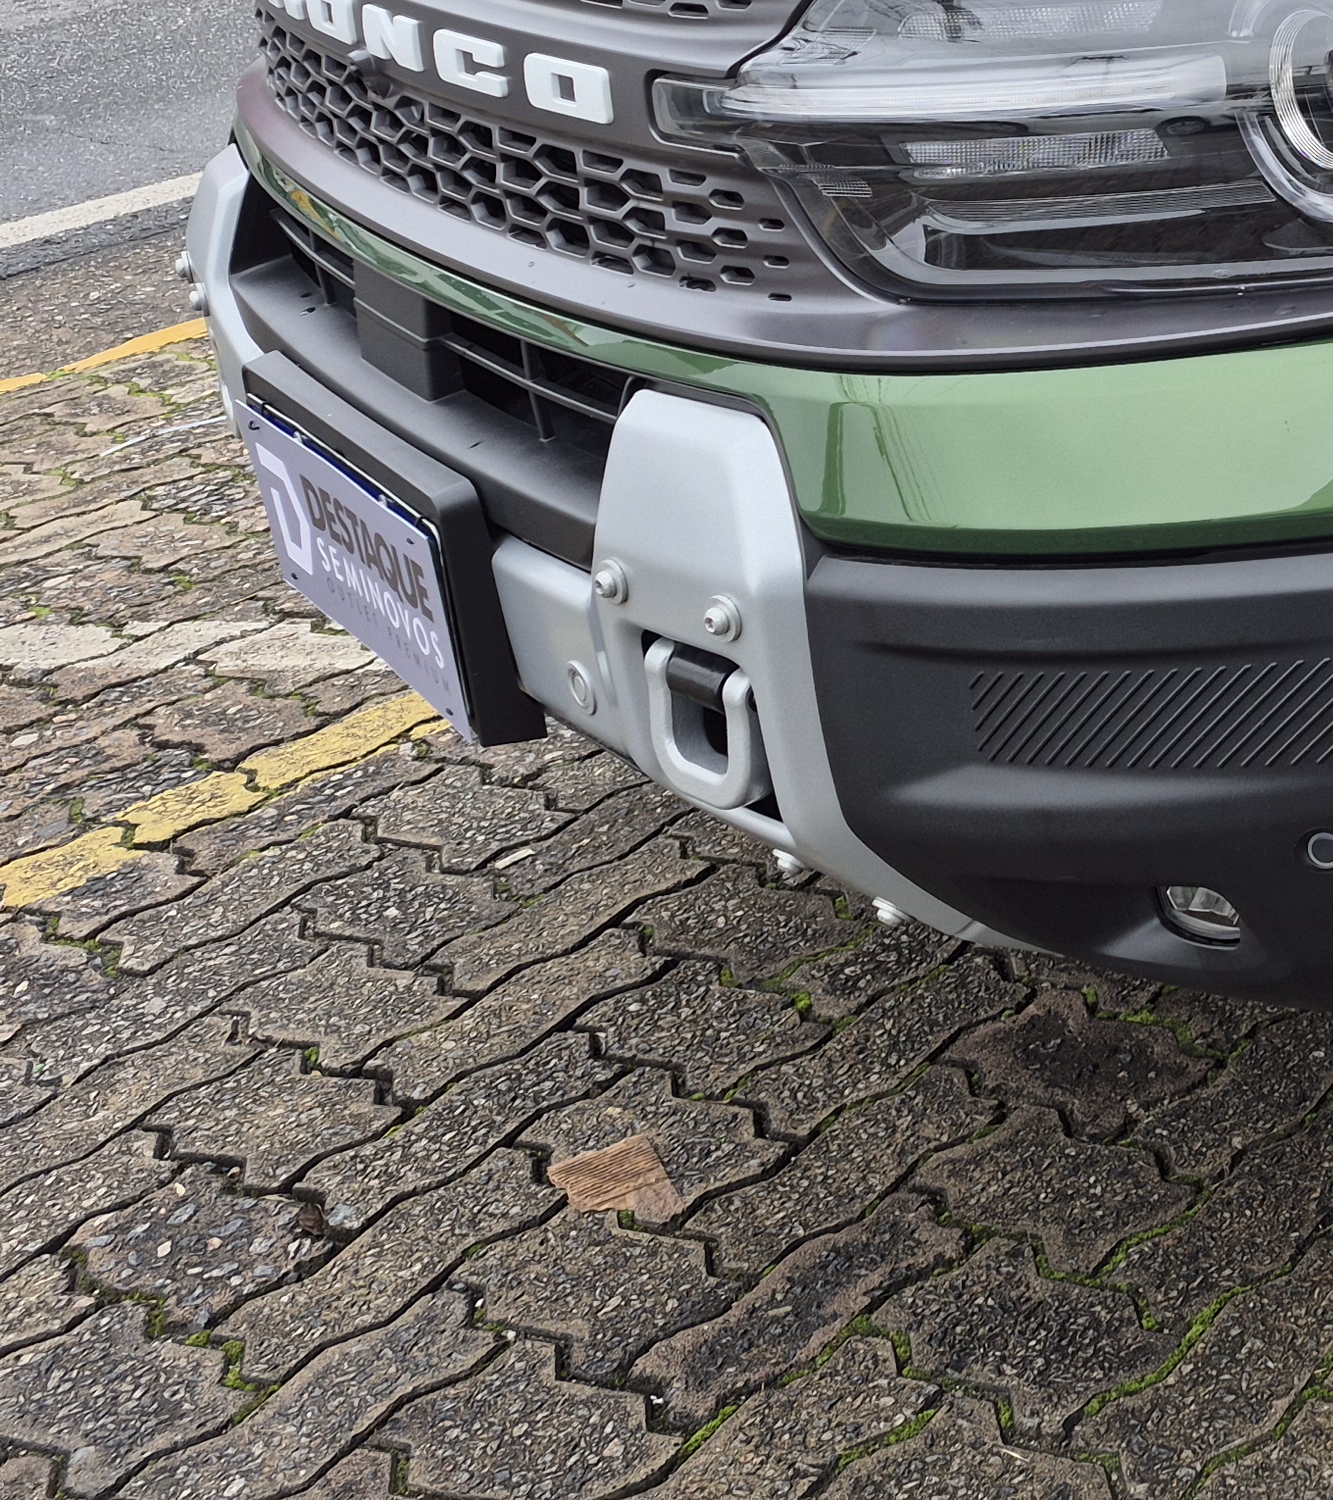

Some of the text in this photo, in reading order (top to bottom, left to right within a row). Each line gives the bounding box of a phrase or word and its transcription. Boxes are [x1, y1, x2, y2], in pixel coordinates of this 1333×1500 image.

[299, 473, 435, 624] DESTAQUE
[316, 536, 446, 671] SEMINOVOS
[326, 576, 451, 693] OUTLET PREMIUM
